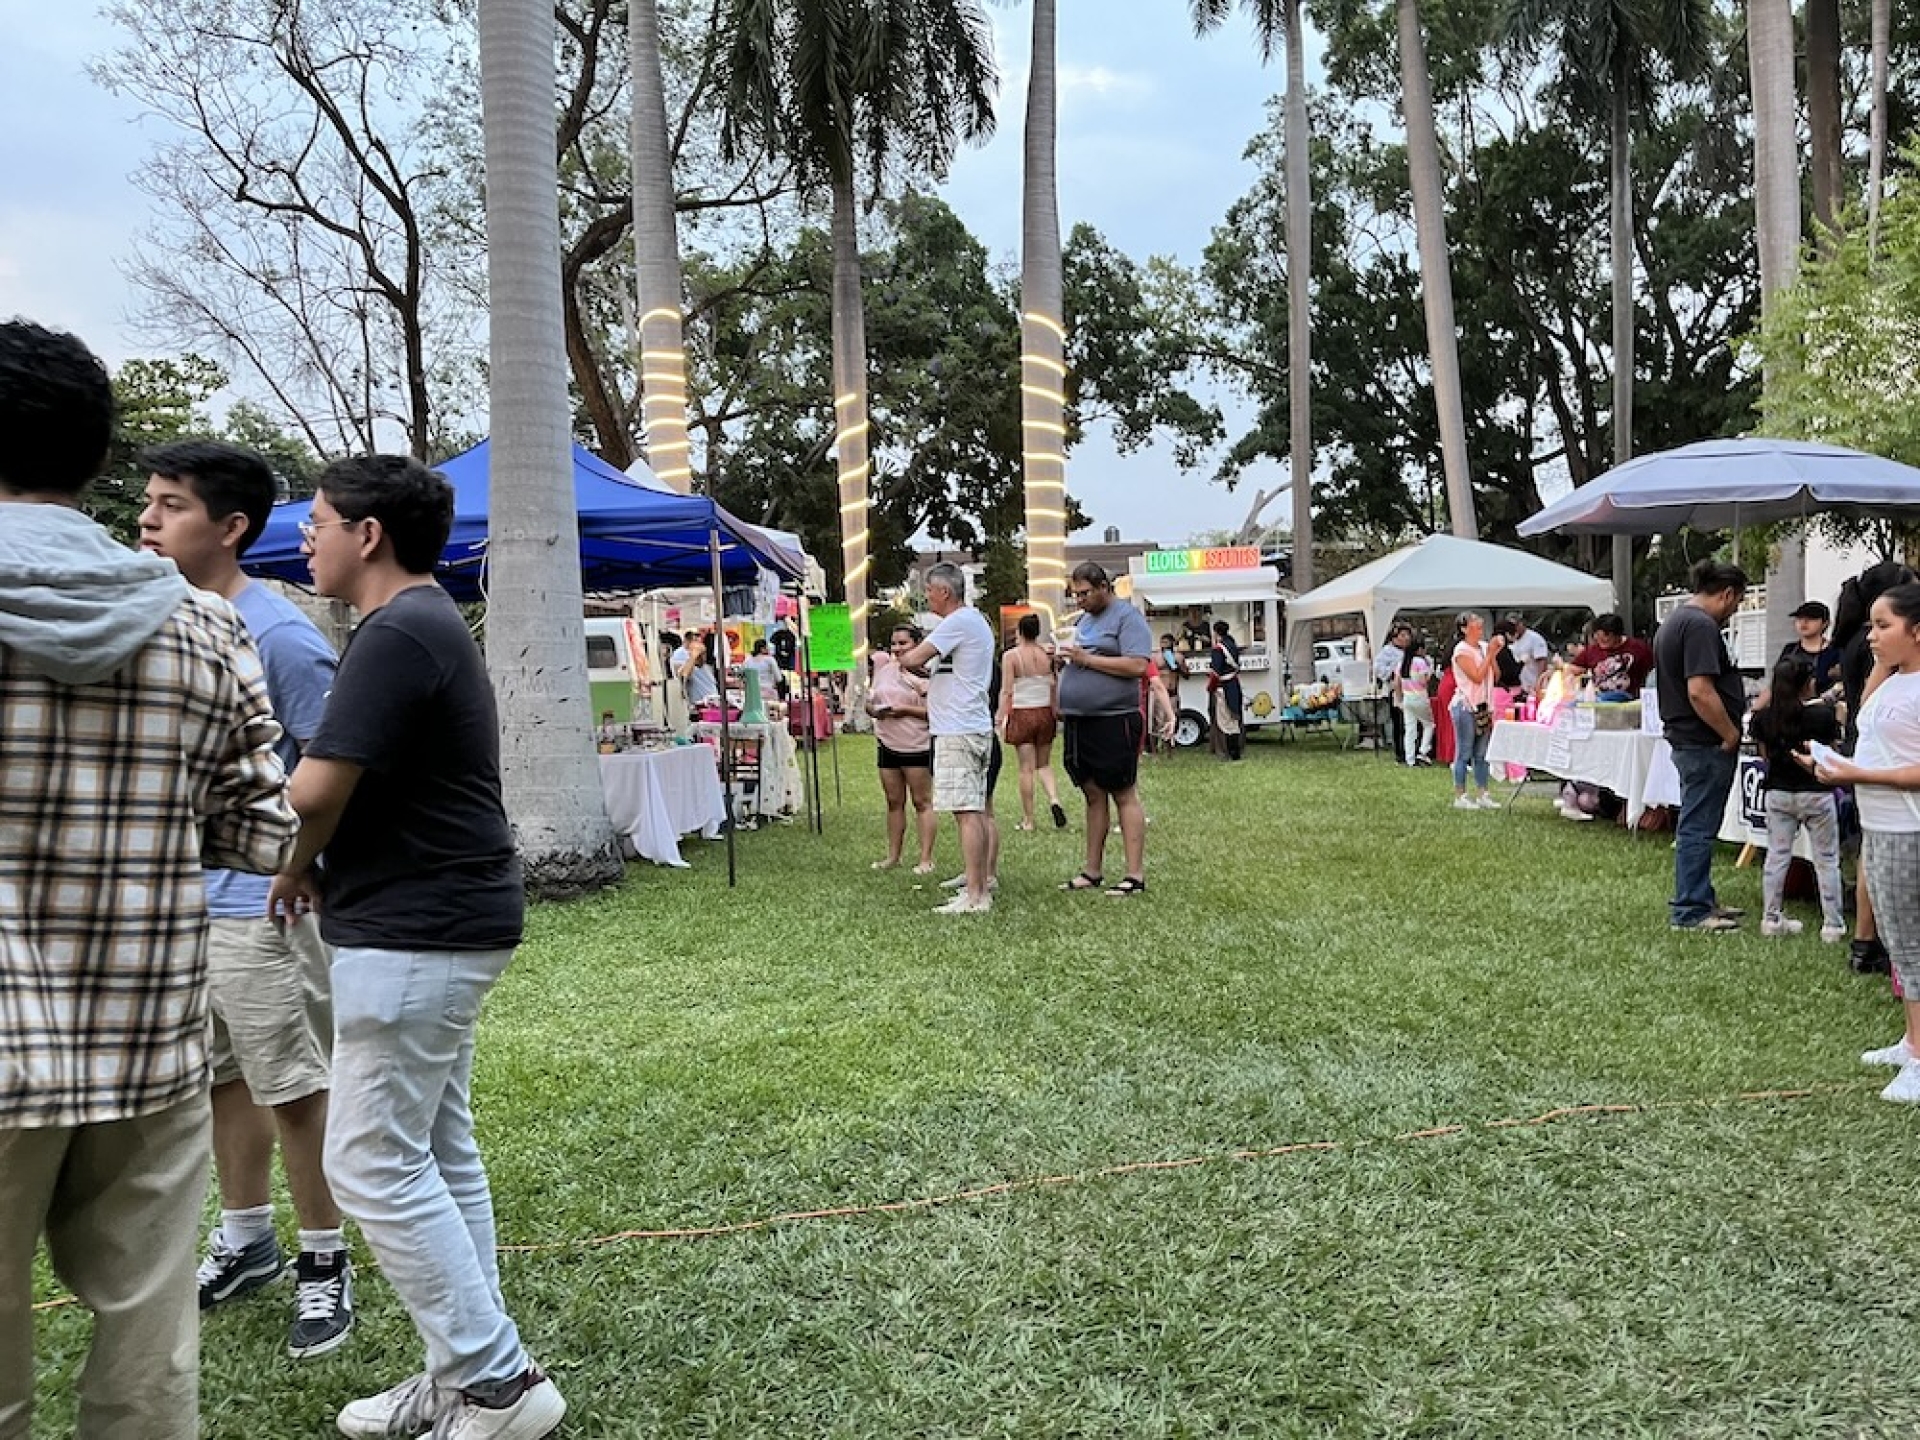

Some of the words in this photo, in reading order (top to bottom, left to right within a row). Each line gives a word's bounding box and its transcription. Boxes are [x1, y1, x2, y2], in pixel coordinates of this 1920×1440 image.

[1149, 552, 1189, 571] ELOTES
[1191, 551, 1200, 569] Y
[1204, 548, 1258, 568] ESQUITES
[1238, 658, 1270, 669] vento
